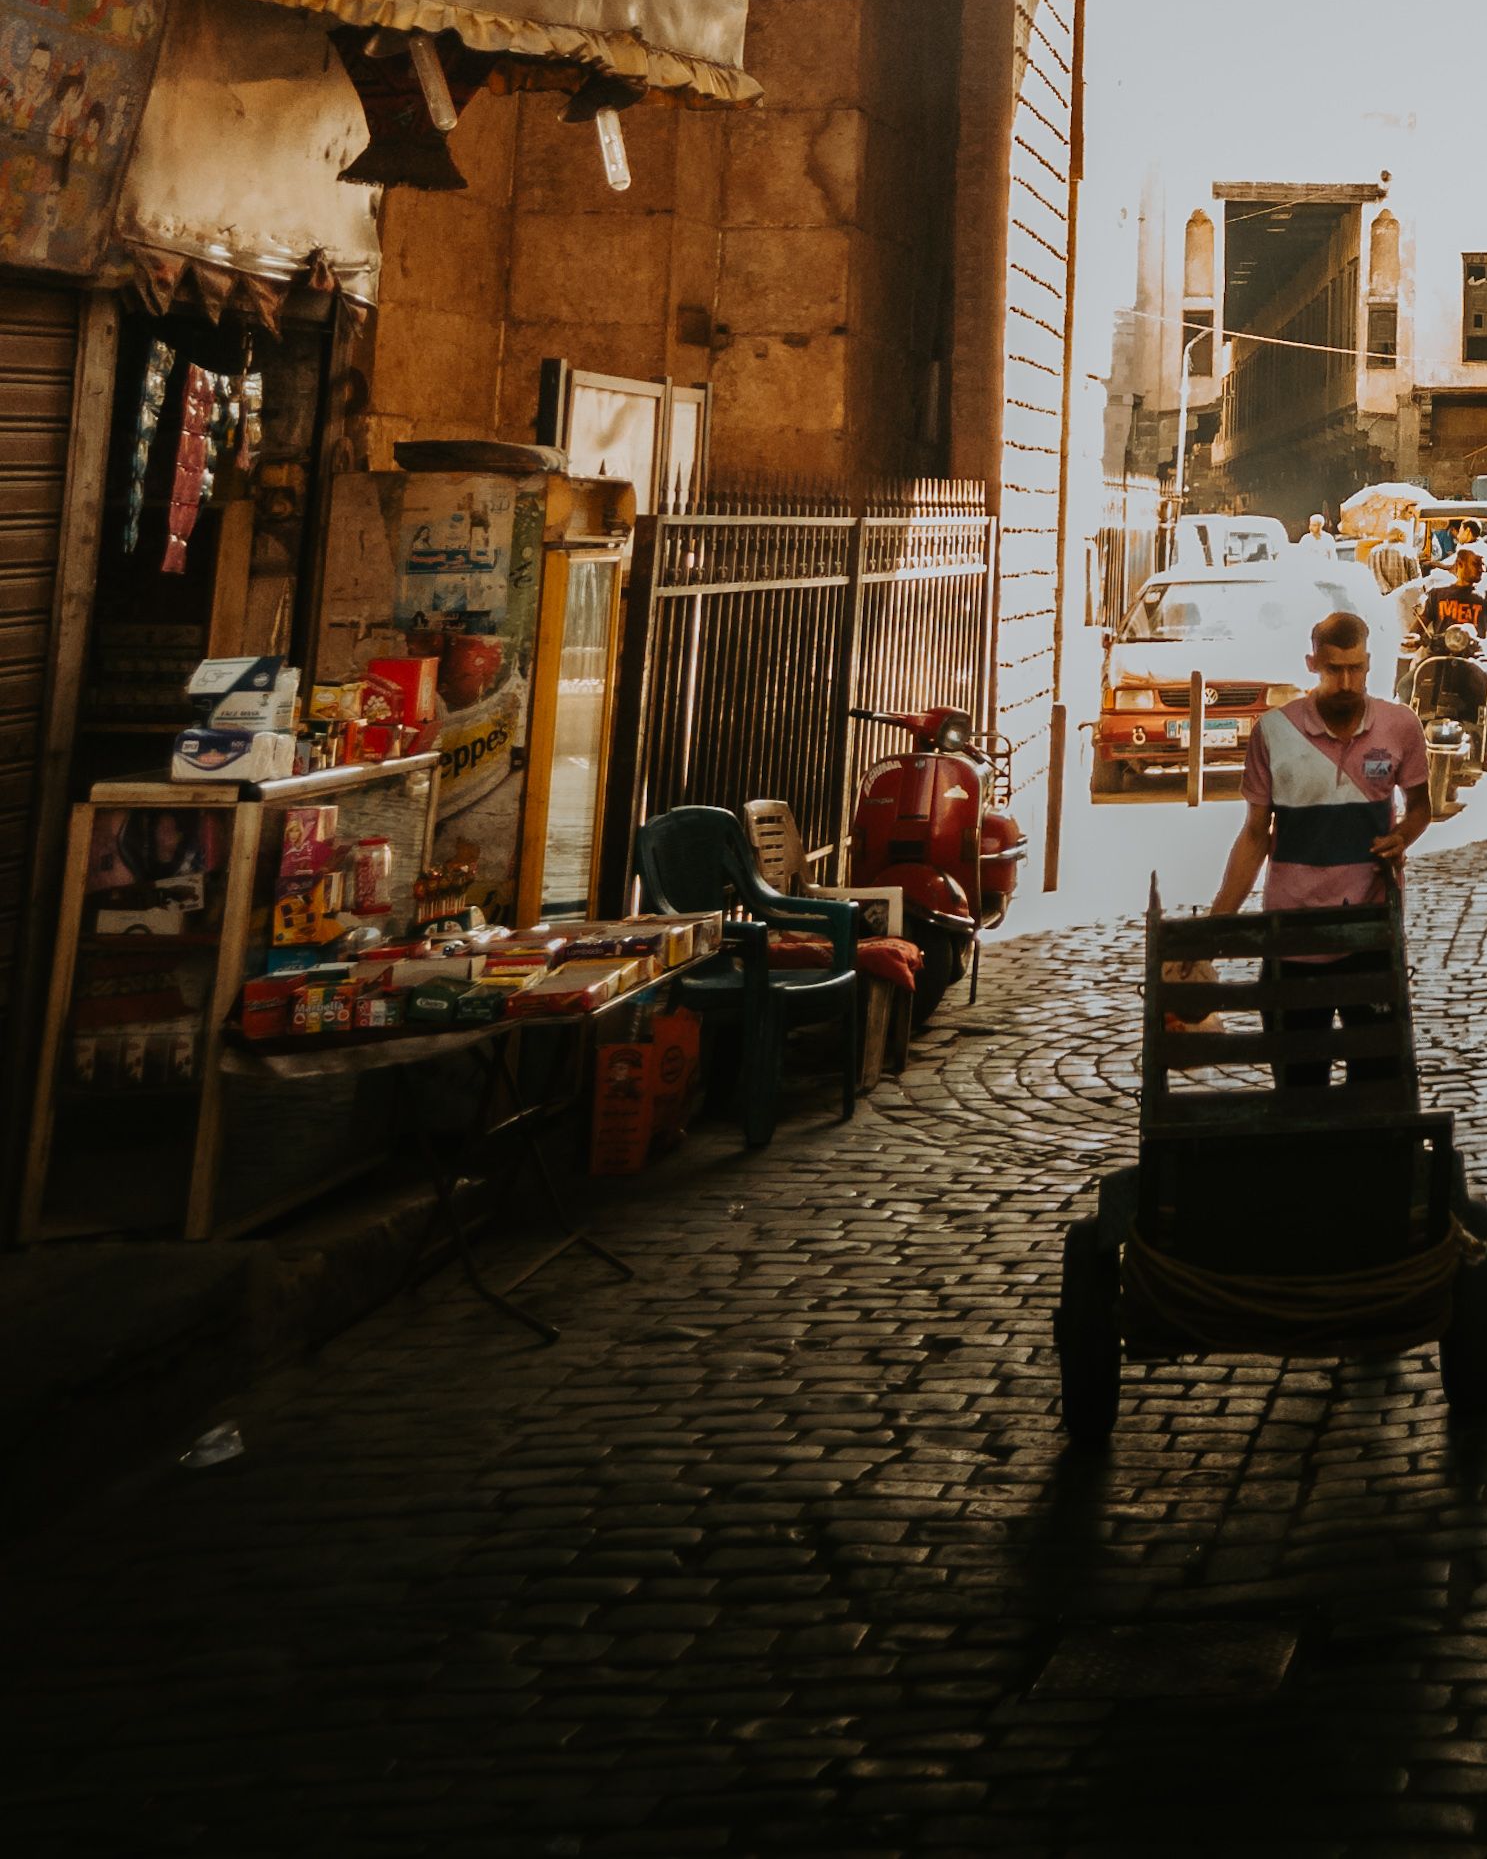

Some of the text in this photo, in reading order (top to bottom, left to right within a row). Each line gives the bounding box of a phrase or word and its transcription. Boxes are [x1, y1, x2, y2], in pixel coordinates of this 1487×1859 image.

[1438, 598, 1483, 628] MEAT
[441, 725, 509, 779] eppes
[294, 998, 345, 1014] Marbella
